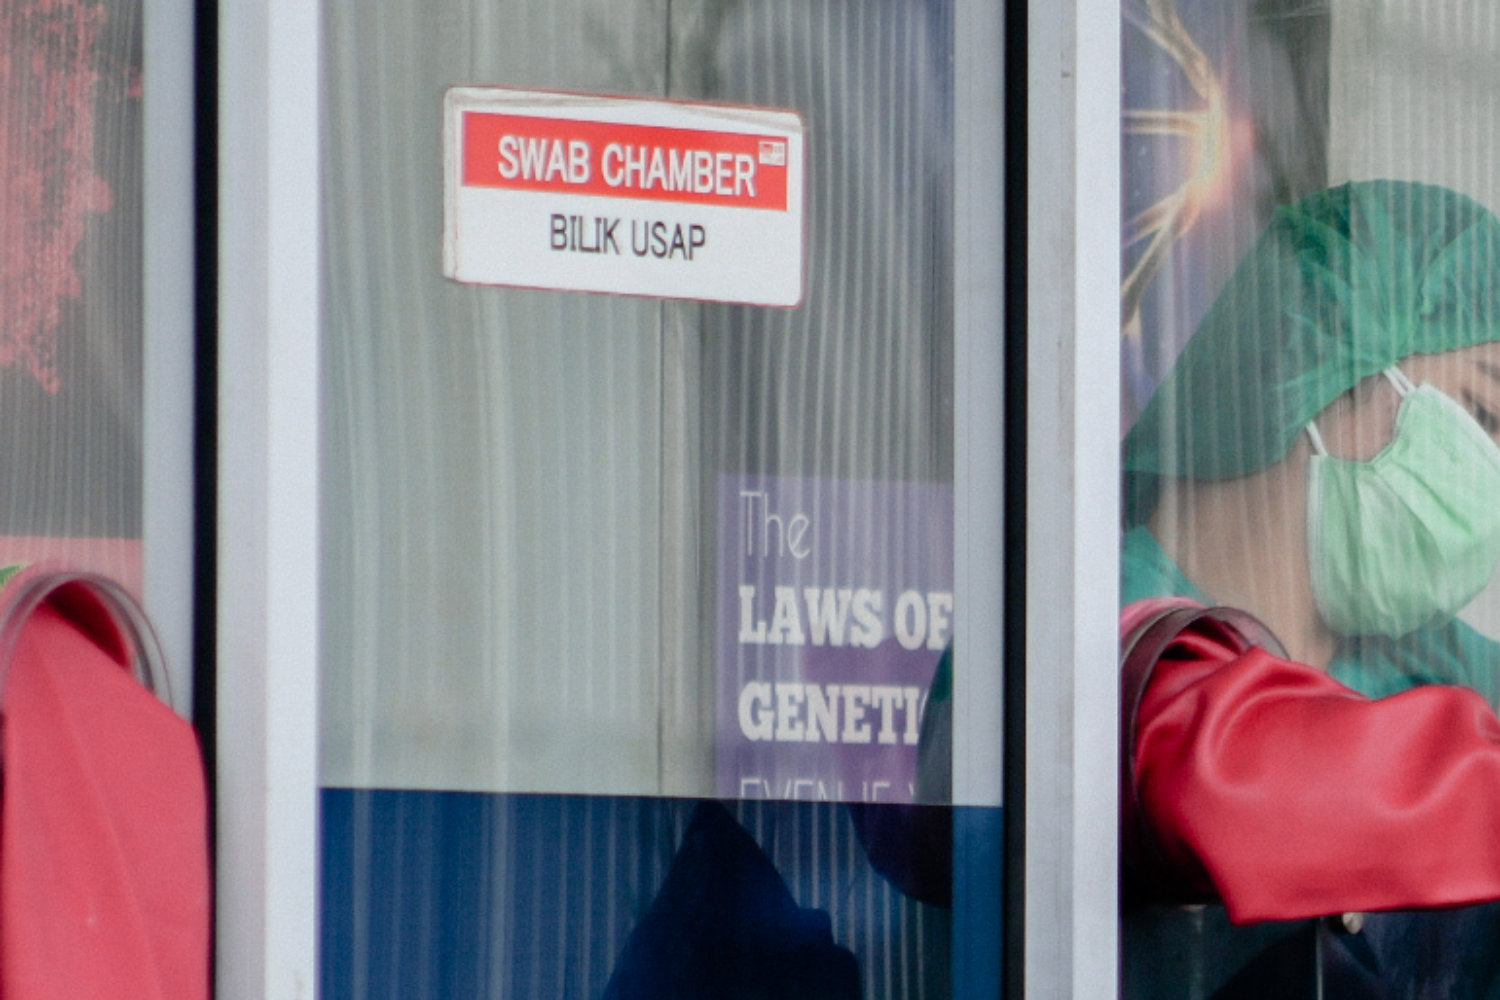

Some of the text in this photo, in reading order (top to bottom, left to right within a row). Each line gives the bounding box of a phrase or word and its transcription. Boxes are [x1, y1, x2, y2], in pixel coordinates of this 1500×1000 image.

[498, 135, 756, 196] SWAB CHAMBER
[549, 213, 706, 260] BILIK USAP
[739, 491, 811, 559] The
[738, 584, 953, 651] LAWS OF
[738, 681, 926, 745] GENETI
